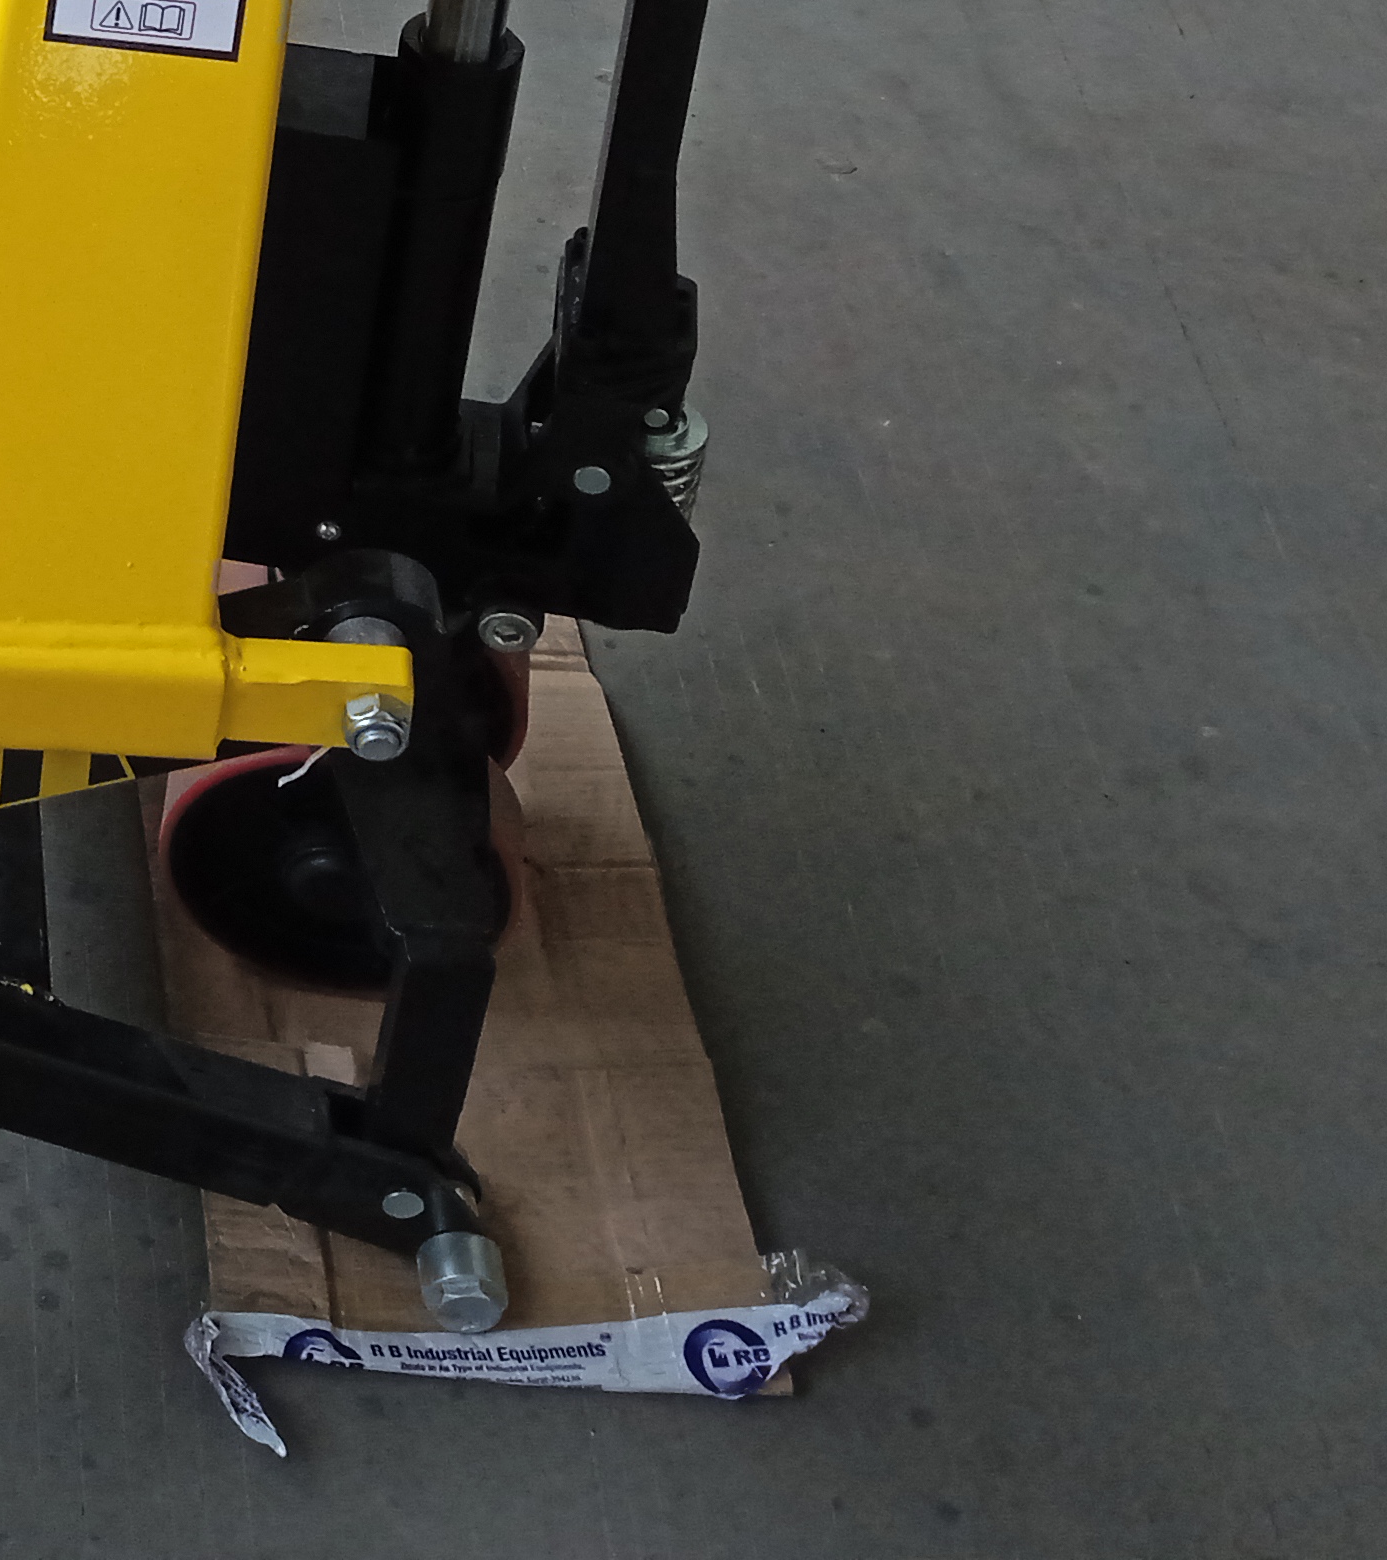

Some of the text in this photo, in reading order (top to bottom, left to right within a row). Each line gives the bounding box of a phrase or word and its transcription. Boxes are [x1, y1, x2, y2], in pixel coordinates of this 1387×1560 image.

[772, 1321, 788, 1338] R
[789, 1314, 802, 1331] B
[370, 1341, 607, 1364] R B Industrial Equipments
[732, 1347, 772, 1367] RB
[452, 1364, 474, 1375] Type
